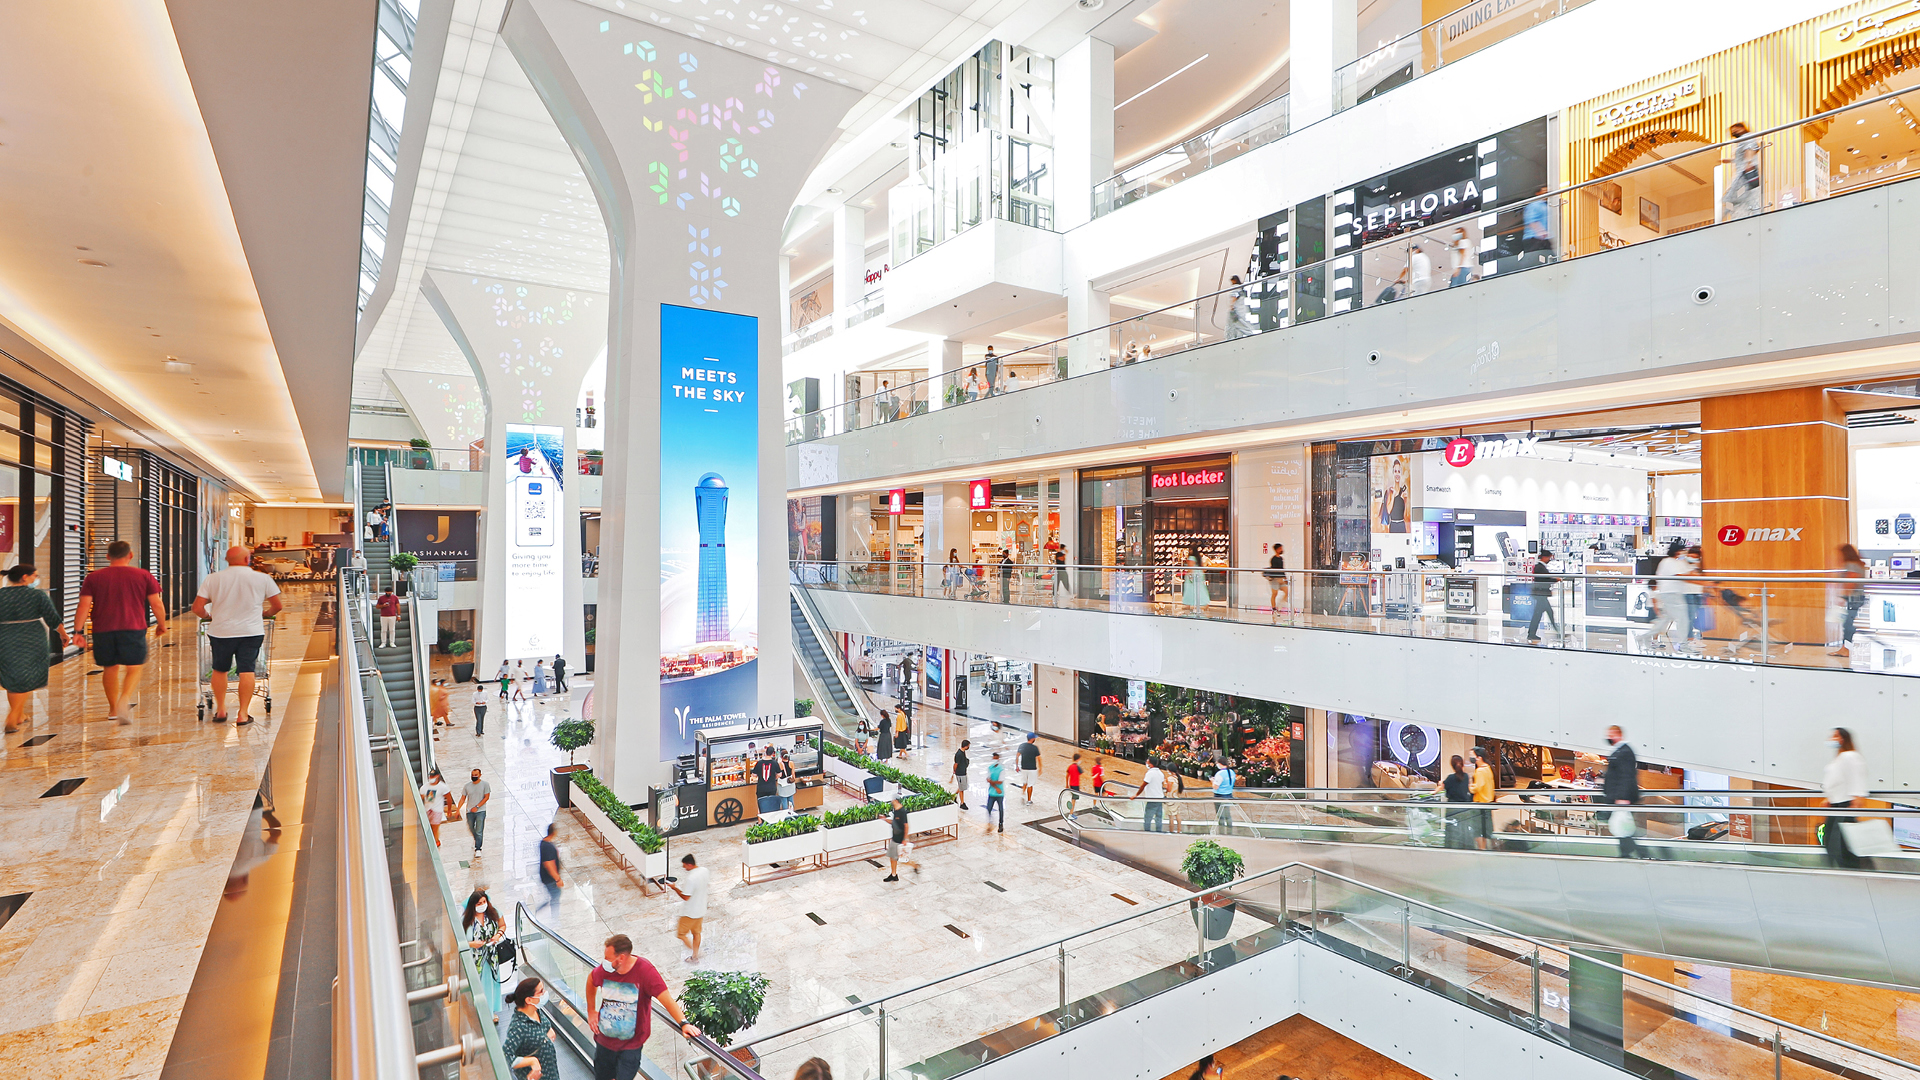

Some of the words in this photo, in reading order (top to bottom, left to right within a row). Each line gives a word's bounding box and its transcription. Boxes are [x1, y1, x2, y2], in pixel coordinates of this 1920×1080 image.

[1449, 2, 1492, 42] DINING
[1595, 82, 1695, 127] L'OCCITANE
[1626, 101, 1676, 122] PROVENCE
[1352, 179, 1479, 236] SEPHORA
[681, 366, 737, 384] MEETS
[672, 385, 706, 400] THE
[712, 388, 745, 403] SKY
[1445, 434, 1540, 467] Emax
[1152, 473, 1179, 488] Foot
[1426, 485, 1451, 493] Smartwatch
[1484, 488, 1502, 496] Samsung
[426, 515, 450, 544] J
[1717, 524, 1803, 547] Emax
[511, 552, 535, 561] Giving
[537, 554, 552, 562] you
[689, 717, 704, 725] THE
[705, 714, 722, 723] PALM
[723, 712, 747, 721] TOWER
[747, 713, 788, 731] PAUL
[680, 804, 699, 815] UL
